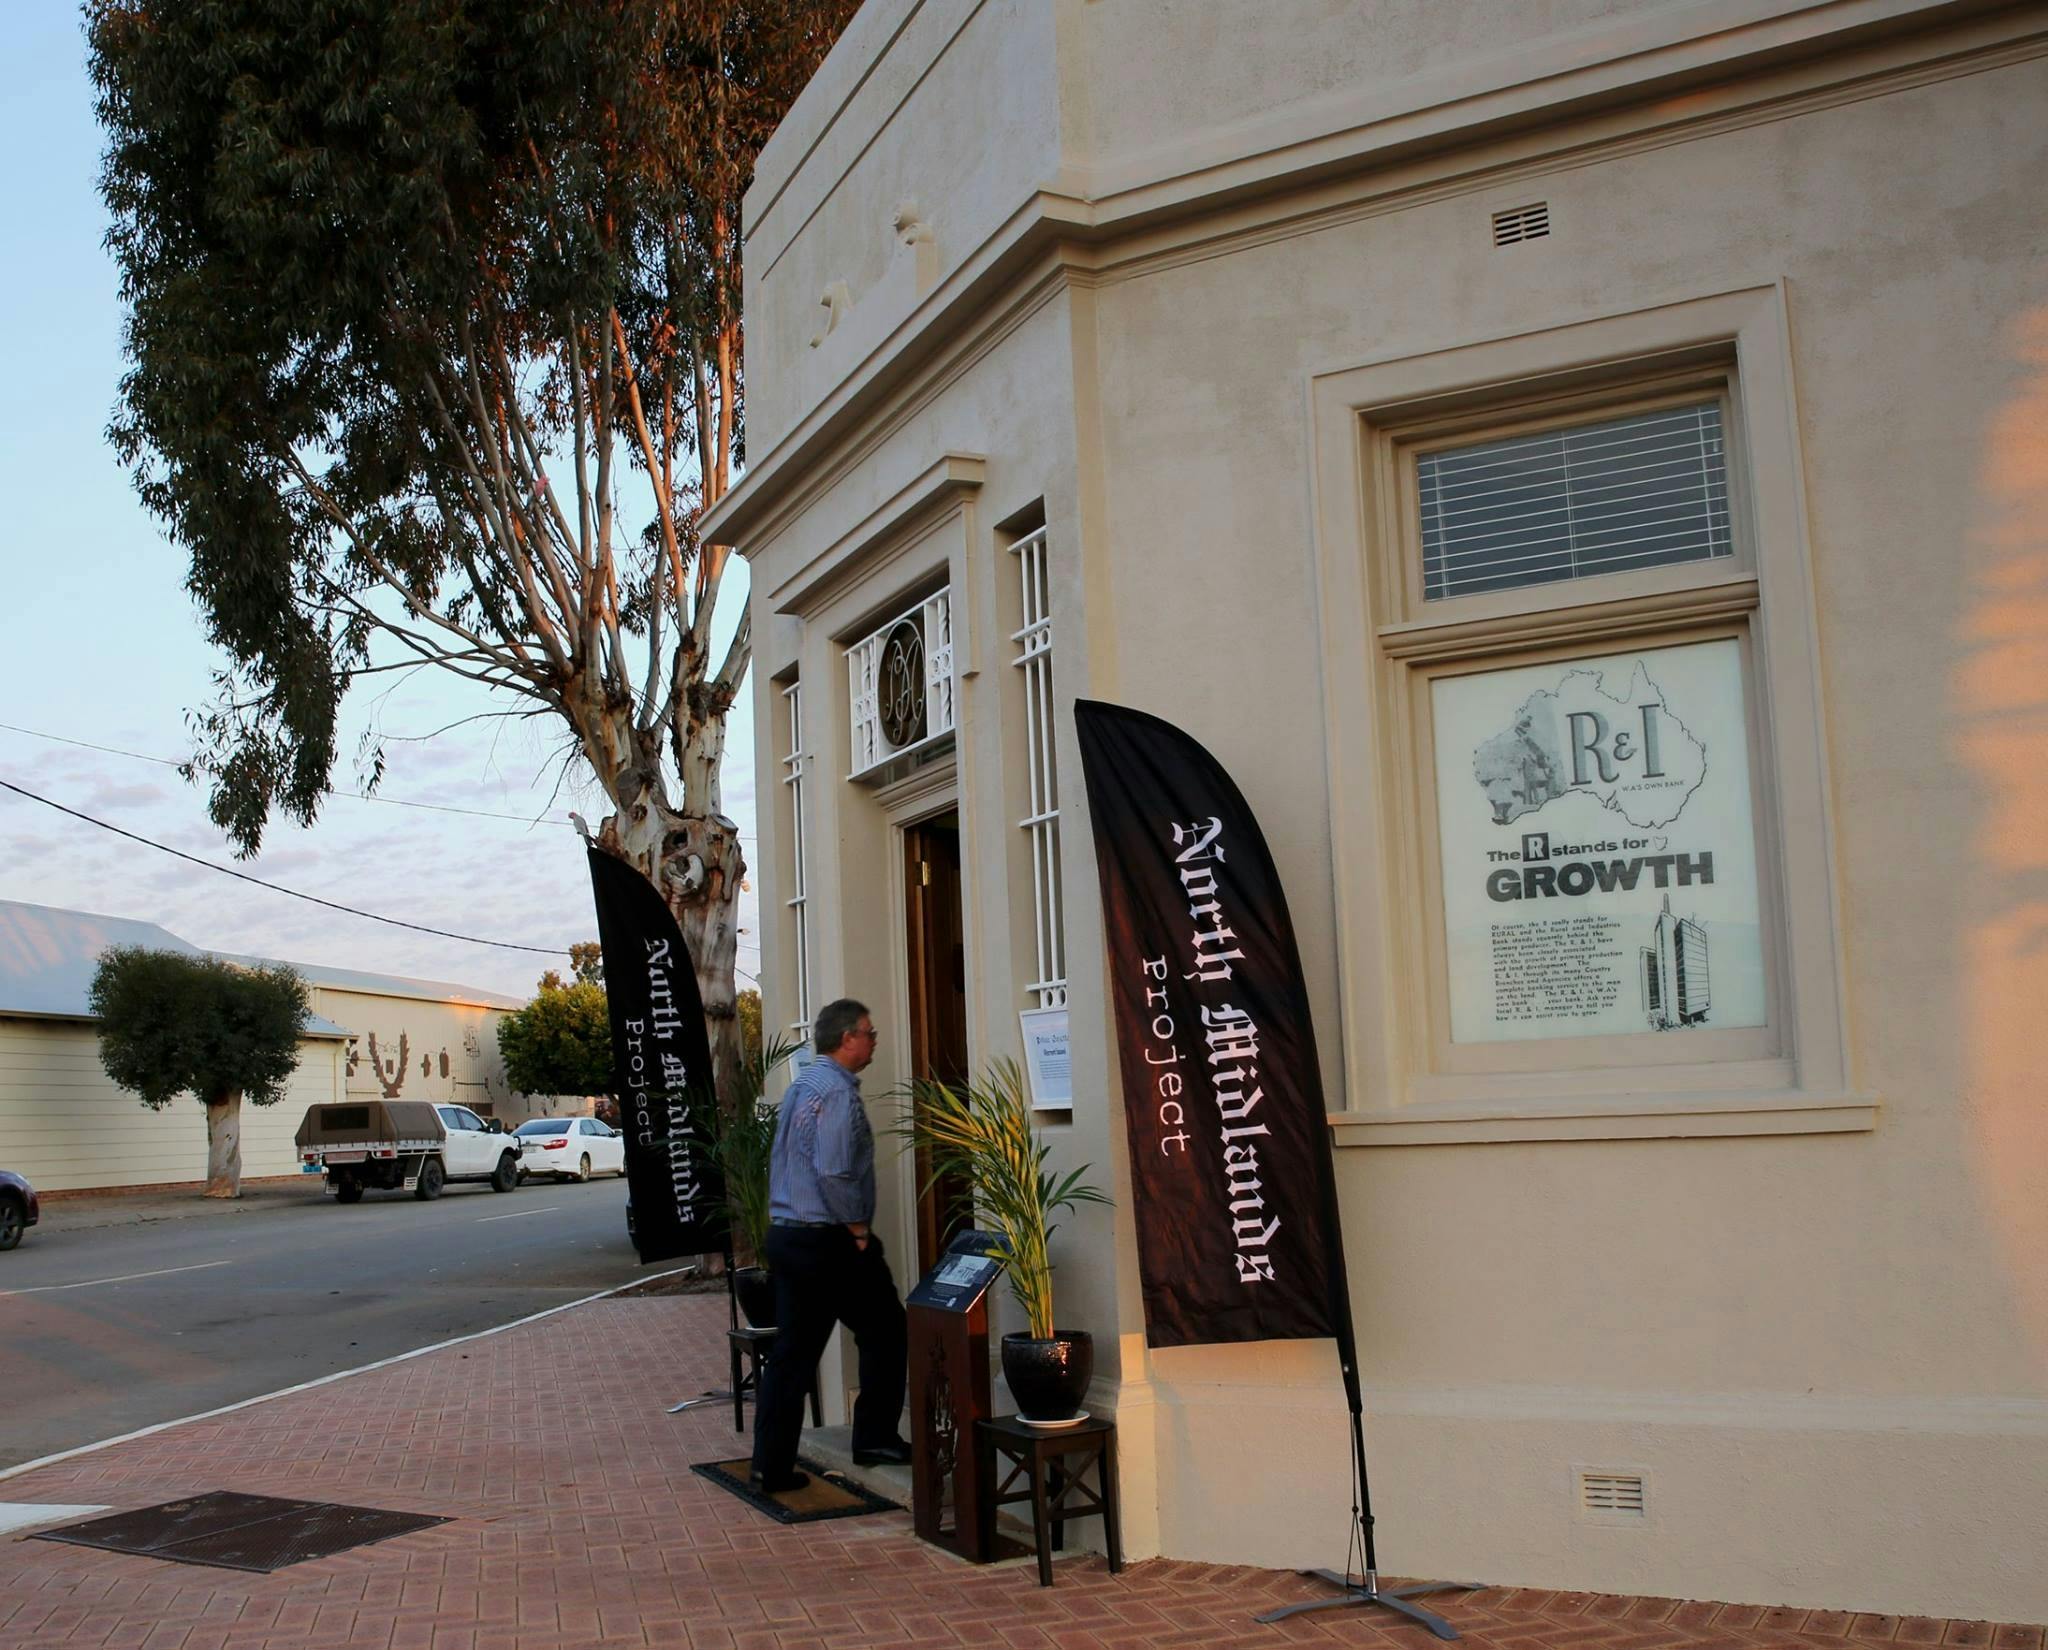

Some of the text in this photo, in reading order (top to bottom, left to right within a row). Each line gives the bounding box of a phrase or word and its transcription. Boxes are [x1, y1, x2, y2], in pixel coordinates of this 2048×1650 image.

[1566, 704, 1665, 786] R&I
[1665, 780, 1684, 788] BANK
[1486, 851, 1714, 902] GROWTH
[1487, 834, 1649, 862] The R stands for
[644, 937, 683, 1040] North
[1143, 954, 1191, 1157] Project
[1172, 816, 1281, 1284] North Midlands
